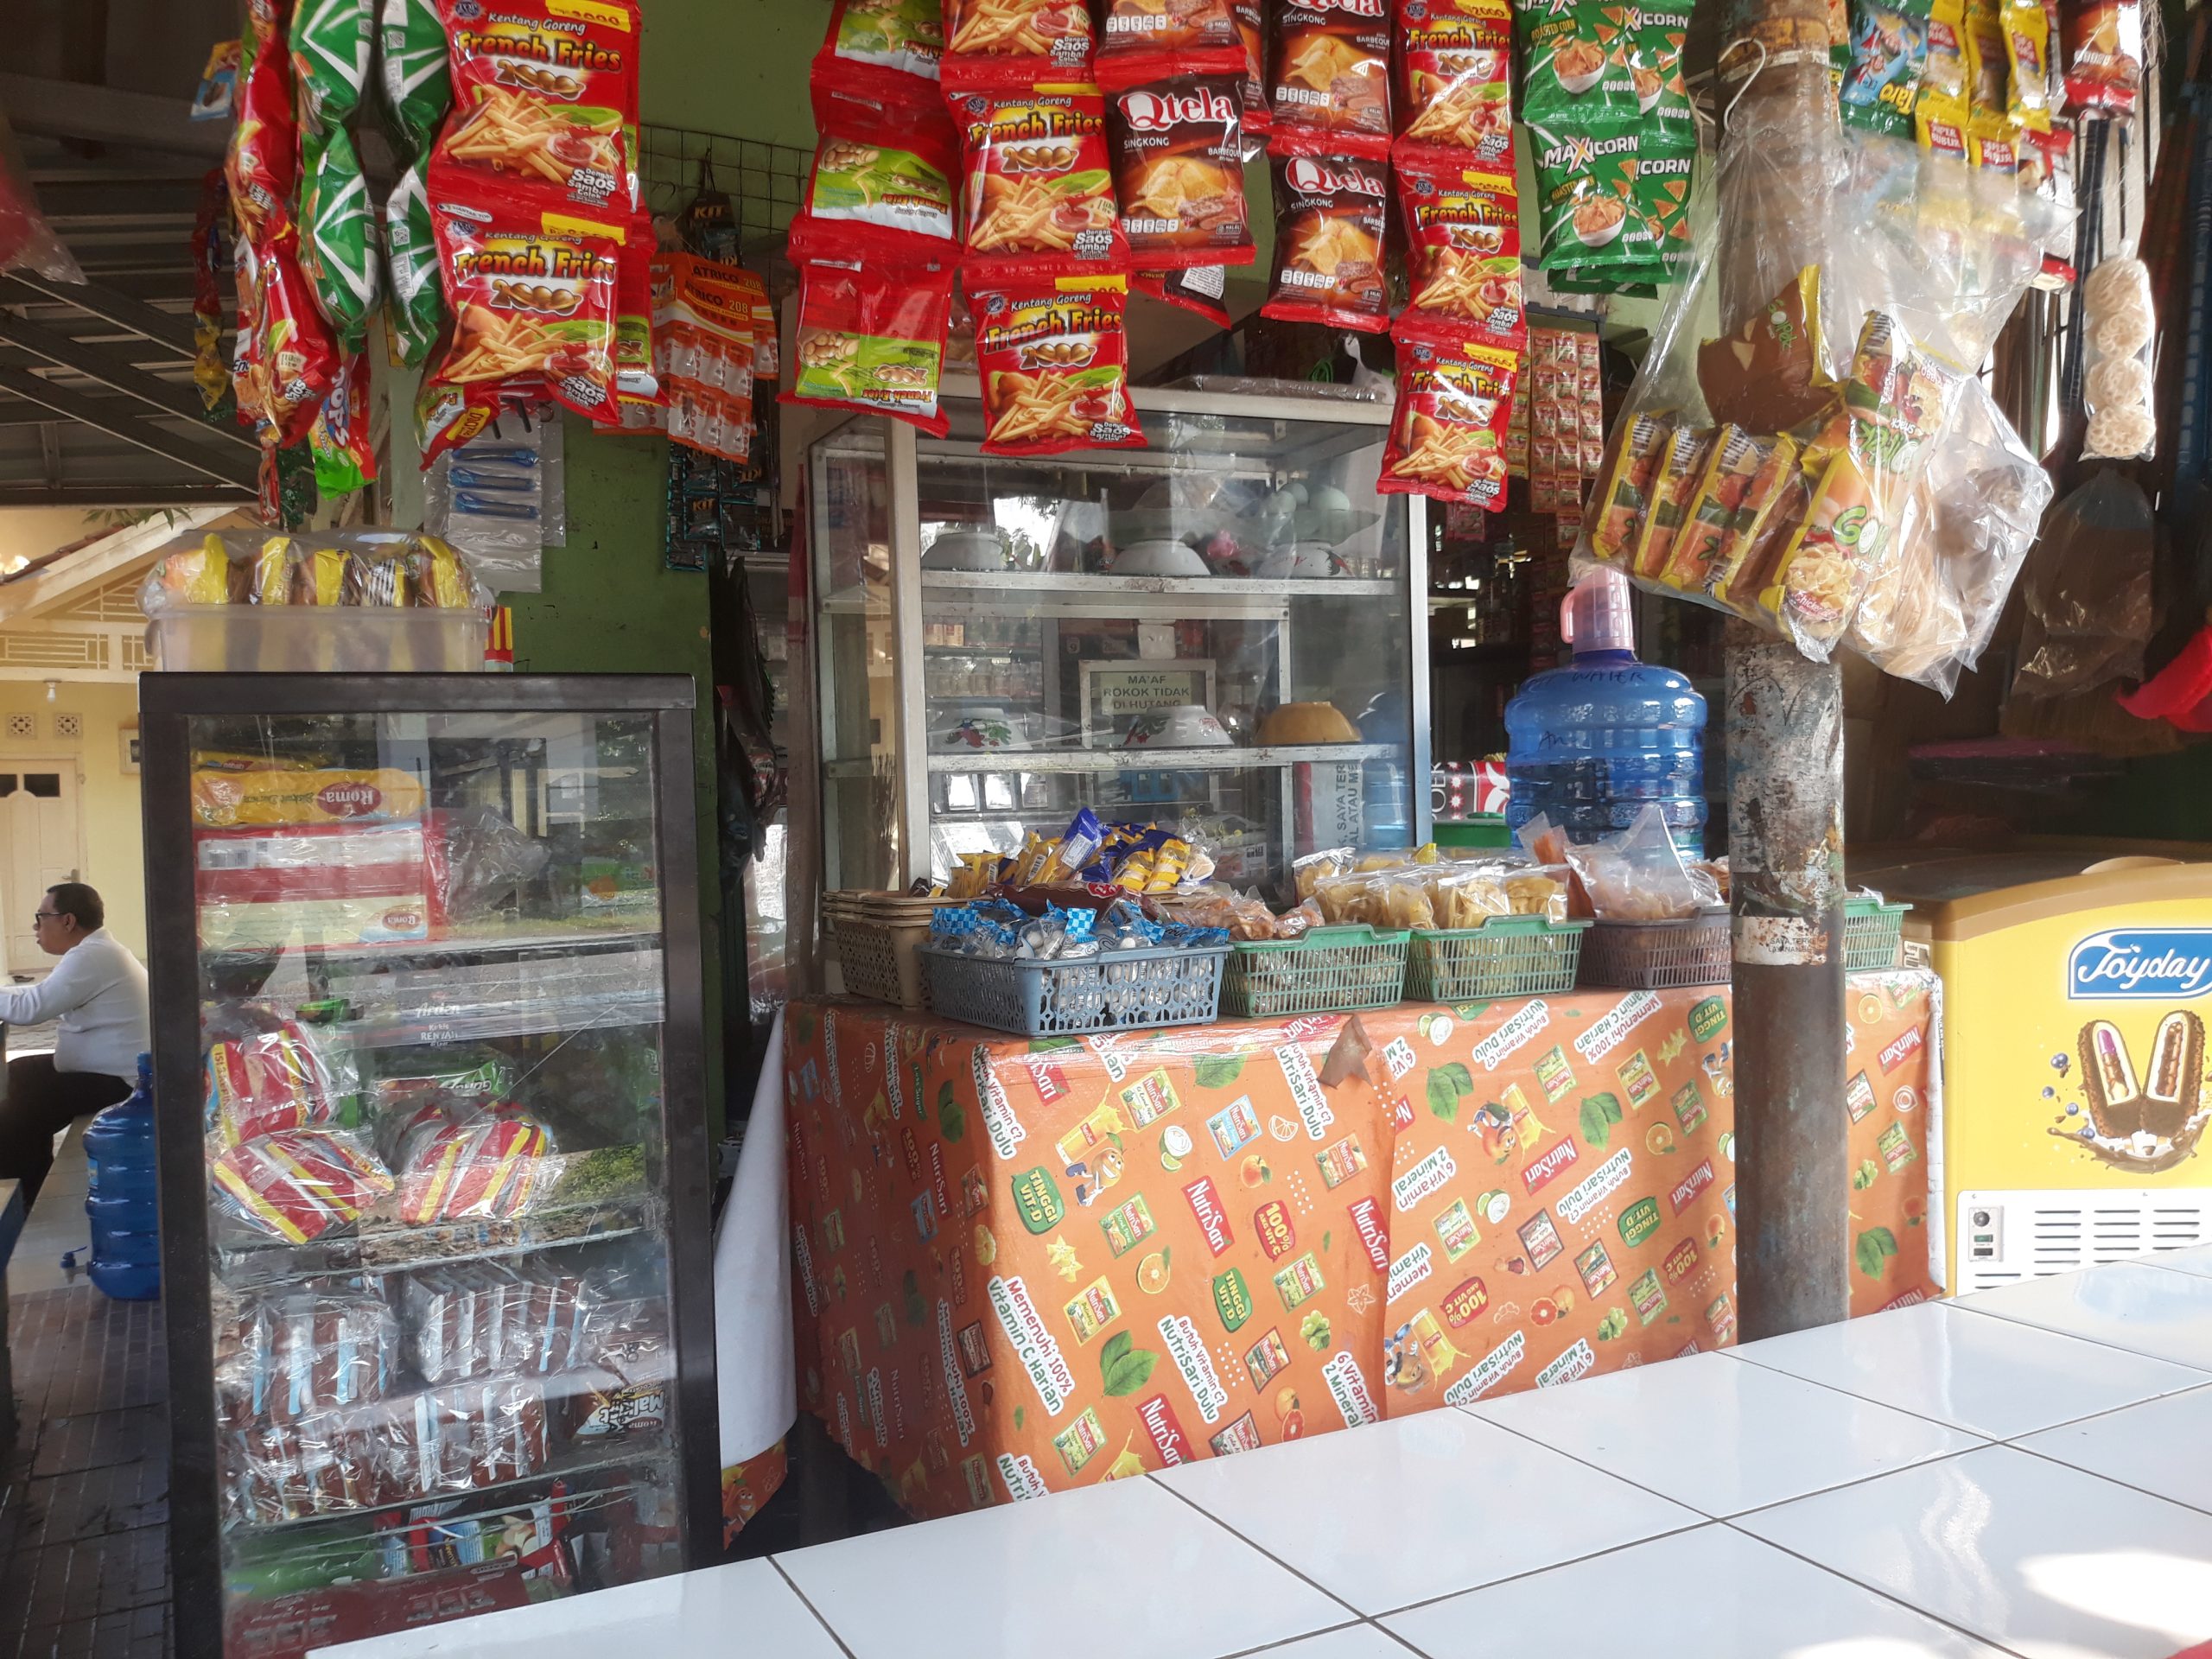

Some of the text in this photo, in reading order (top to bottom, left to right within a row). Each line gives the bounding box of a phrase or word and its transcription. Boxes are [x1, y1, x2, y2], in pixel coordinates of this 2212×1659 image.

[487, 12, 538, 30] Kentang
[543, 19, 586, 35] Goreng
[1282, 13, 1326, 26] SINGKONG
[1530, 18, 1577, 42] ROASTED CORN
[456, 31, 622, 71] French Fries
[1053, 38, 1090, 51] Saos
[1408, 27, 1472, 50] French
[994, 97, 1071, 109] Kentang Goreng
[1117, 86, 1238, 130] Qtela
[1878, 82, 1916, 116] Taro
[969, 112, 1103, 148] French Fries
[1123, 137, 1169, 149] SINGKONG
[1481, 135, 1509, 149] Saos
[1542, 135, 1639, 177] MAXICORN
[572, 168, 616, 192] Saos
[1285, 156, 1386, 197] Qtela
[1290, 198, 1333, 210] SINGKONG
[1438, 189, 1496, 201] Kentang Goreng
[1418, 202, 1519, 227] French Fries
[1075, 232, 1114, 245] Saos
[455, 245, 616, 284] French Fries
[691, 265, 762, 291] ATRICO 208
[728, 300, 749, 313] 208
[1011, 294, 1091, 312] Kentang Goreng
[1491, 308, 1518, 323] Saos
[984, 308, 1122, 353] French Fries
[1436, 356, 1467, 370] Kentang
[1468, 361, 1494, 375] Goreng
[1103, 688, 1190, 697] ROKOK TIDAK
[1128, 675, 1166, 684] MA'AF
[1113, 700, 1181, 709] DI HUTANG
[325, 789, 375, 805] Roma
[1336, 795, 1346, 830] SAYA
[1348, 788, 1359, 823] ATAU
[2077, 943, 2211, 990] Joyday
[1475, 1000, 1546, 1059] NutriSari Dulu
[1495, 1014, 1547, 1058] Butuh Vitamin
[1576, 1018, 1612, 1050] Harian
[1588, 995, 1660, 1059] Memenuhi 100%
[1694, 1010, 1726, 1037] TINGGI
[1878, 1027, 1923, 1066] NutriSari
[1144, 1077, 1163, 1114] NutriSari
[1278, 1046, 1322, 1137] utriSari Dulu
[1304, 1068, 1325, 1111] Vitamin
[1545, 1068, 1570, 1090] NutriSari
[1628, 1072, 1654, 1094] NutriSari
[988, 1121, 1013, 1156] Dulu
[1230, 1105, 1247, 1140] NutriSari
[1338, 1140, 1355, 1173] NutriSari
[1524, 1138, 1577, 1184] NutriSari
[929, 1142, 947, 1215] NutriSari
[1395, 1156, 1438, 1196] Mineral
[1398, 1169, 1446, 1208] Vitamin
[1559, 1150, 1630, 1214] NutriSari Dulu
[1580, 1166, 1629, 1211] Butuh Vitamin
[1671, 1163, 1713, 1205] NutriSari
[1020, 1185, 1042, 1223] VIT-D
[1029, 1170, 1058, 1224] TINGGI
[1123, 1201, 1142, 1238] NutriSari
[1187, 1179, 1224, 1251] NutriSari
[1265, 1202, 1291, 1250] 100%
[1624, 1212, 1660, 1241] TINGGI
[1351, 1198, 1389, 1270] NutriSari
[1446, 1223, 1473, 1247] NutriSari
[1294, 1261, 1311, 1295] NutriSari
[1389, 1246, 1429, 1281] Vitami
[1669, 1249, 1698, 1281] 100%
[1085, 1287, 1107, 1324] NutriSari
[1224, 1271, 1246, 1321] TINGGI
[1448, 1289, 1487, 1324] 100%
[988, 1279, 1061, 1412] Vitamin C Harian
[1007, 1280, 1072, 1395] Memenuhi 100%
[1160, 1319, 1217, 1421] NutriSari Dulu
[1178, 1319, 1217, 1392] Butuh Vitamin
[1260, 1338, 1277, 1373] NutriSari
[1446, 1333, 1523, 1402] NutriSari Dulu
[1469, 1348, 1522, 1398] Butuh Vitamin
[1344, 1364, 1377, 1424] Vitamin
[1075, 1417, 1096, 1455] NutriSari
[1141, 1397, 1182, 1466] NutriSar
[1018, 1458, 1039, 1490] Butuh
